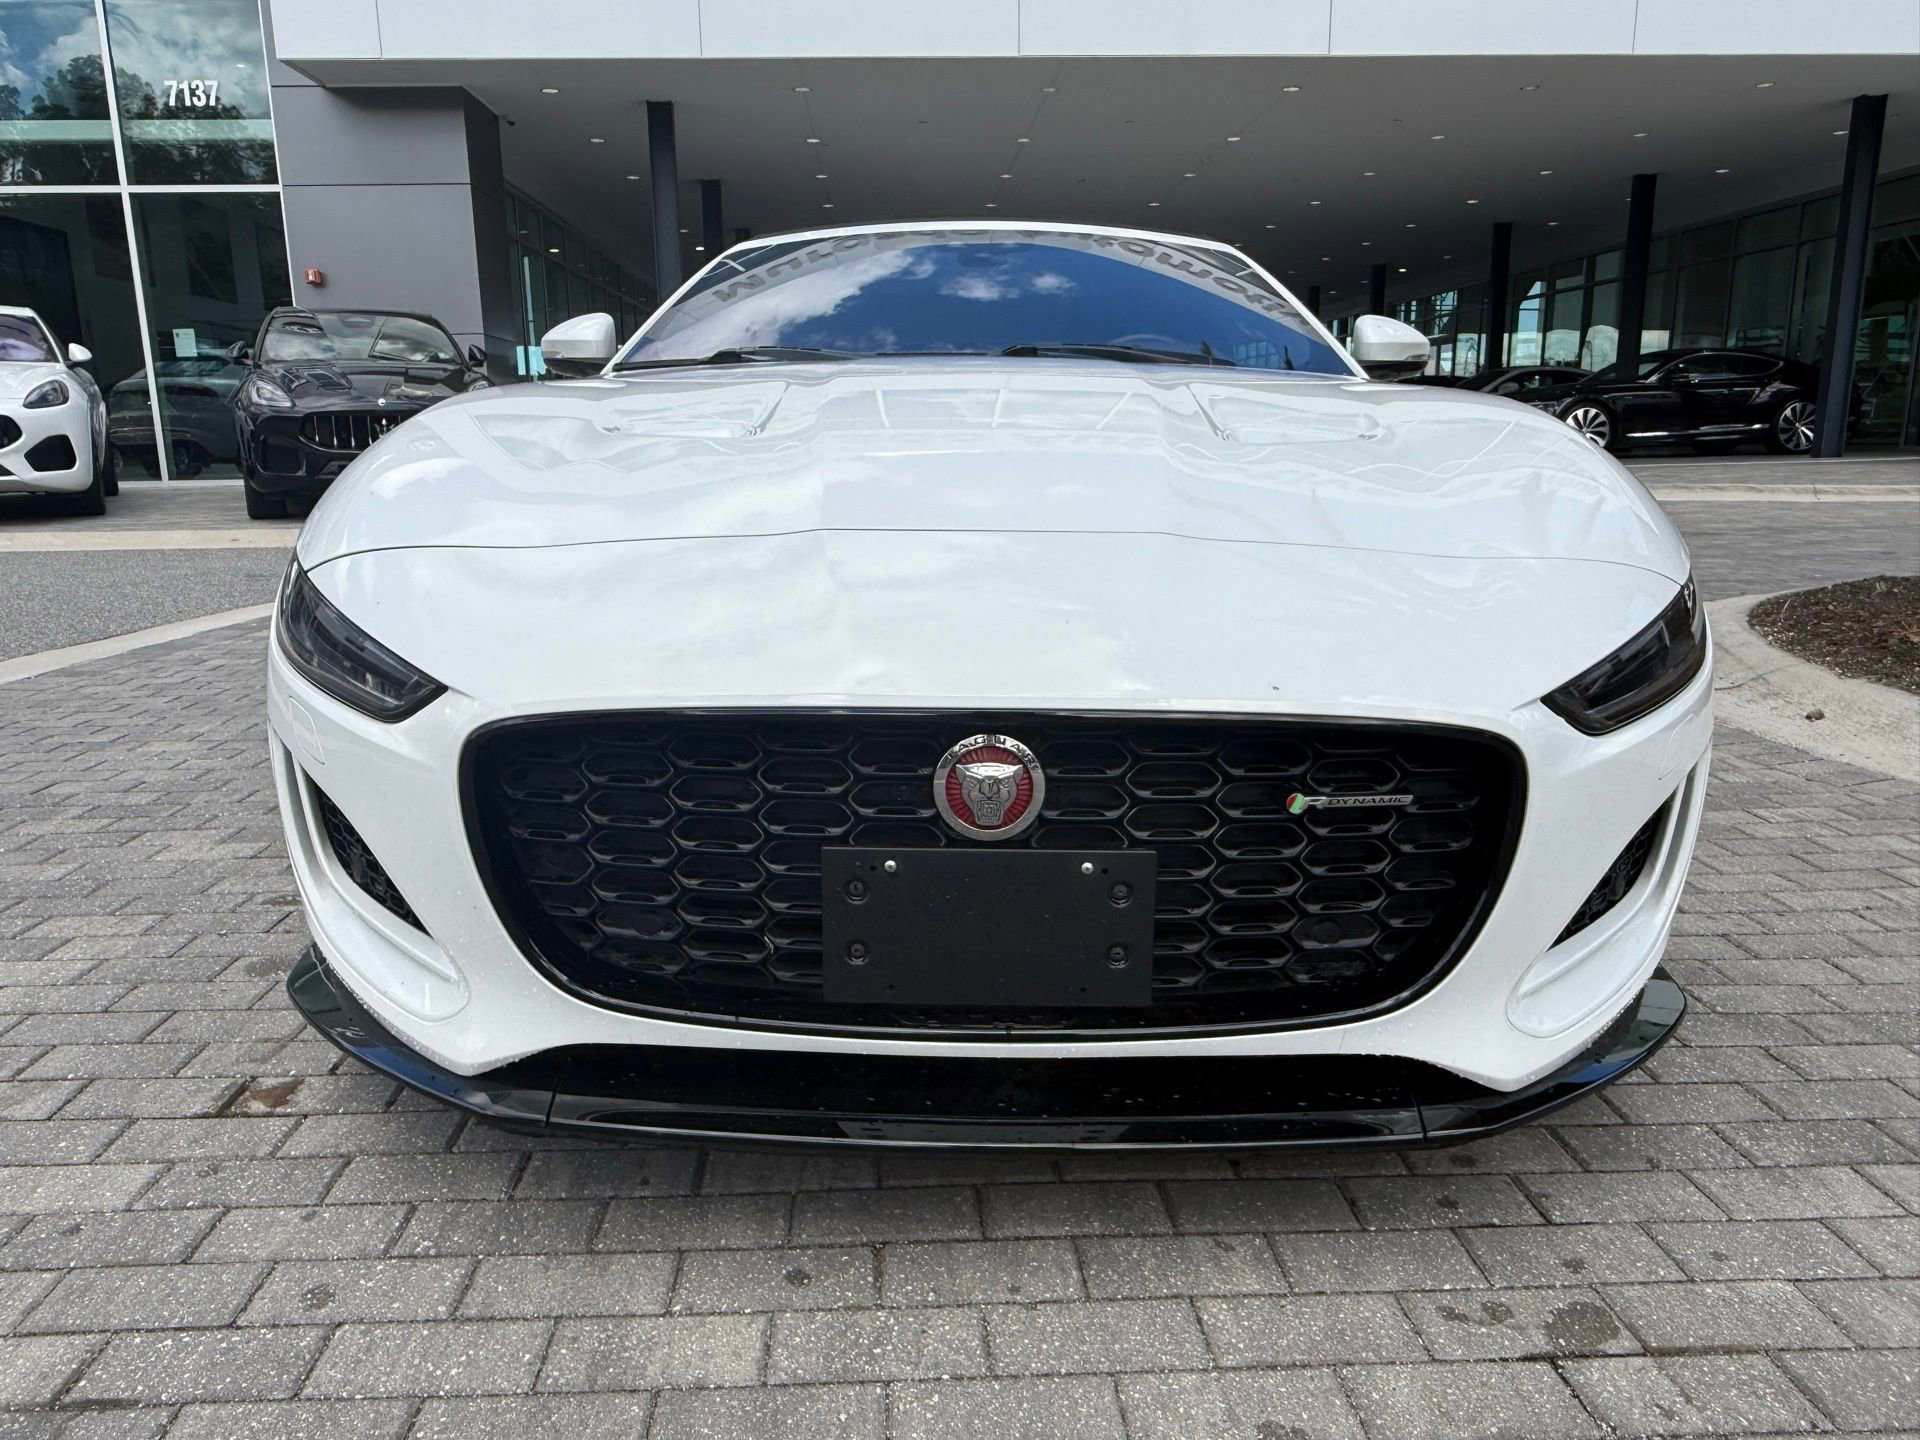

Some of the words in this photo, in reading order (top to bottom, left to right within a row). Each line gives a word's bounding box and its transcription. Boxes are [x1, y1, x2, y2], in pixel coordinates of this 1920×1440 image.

[163, 80, 218, 107] 7137
[941, 734, 1041, 772] JAGUAR
[1327, 796, 1411, 806] DYNAMIC
